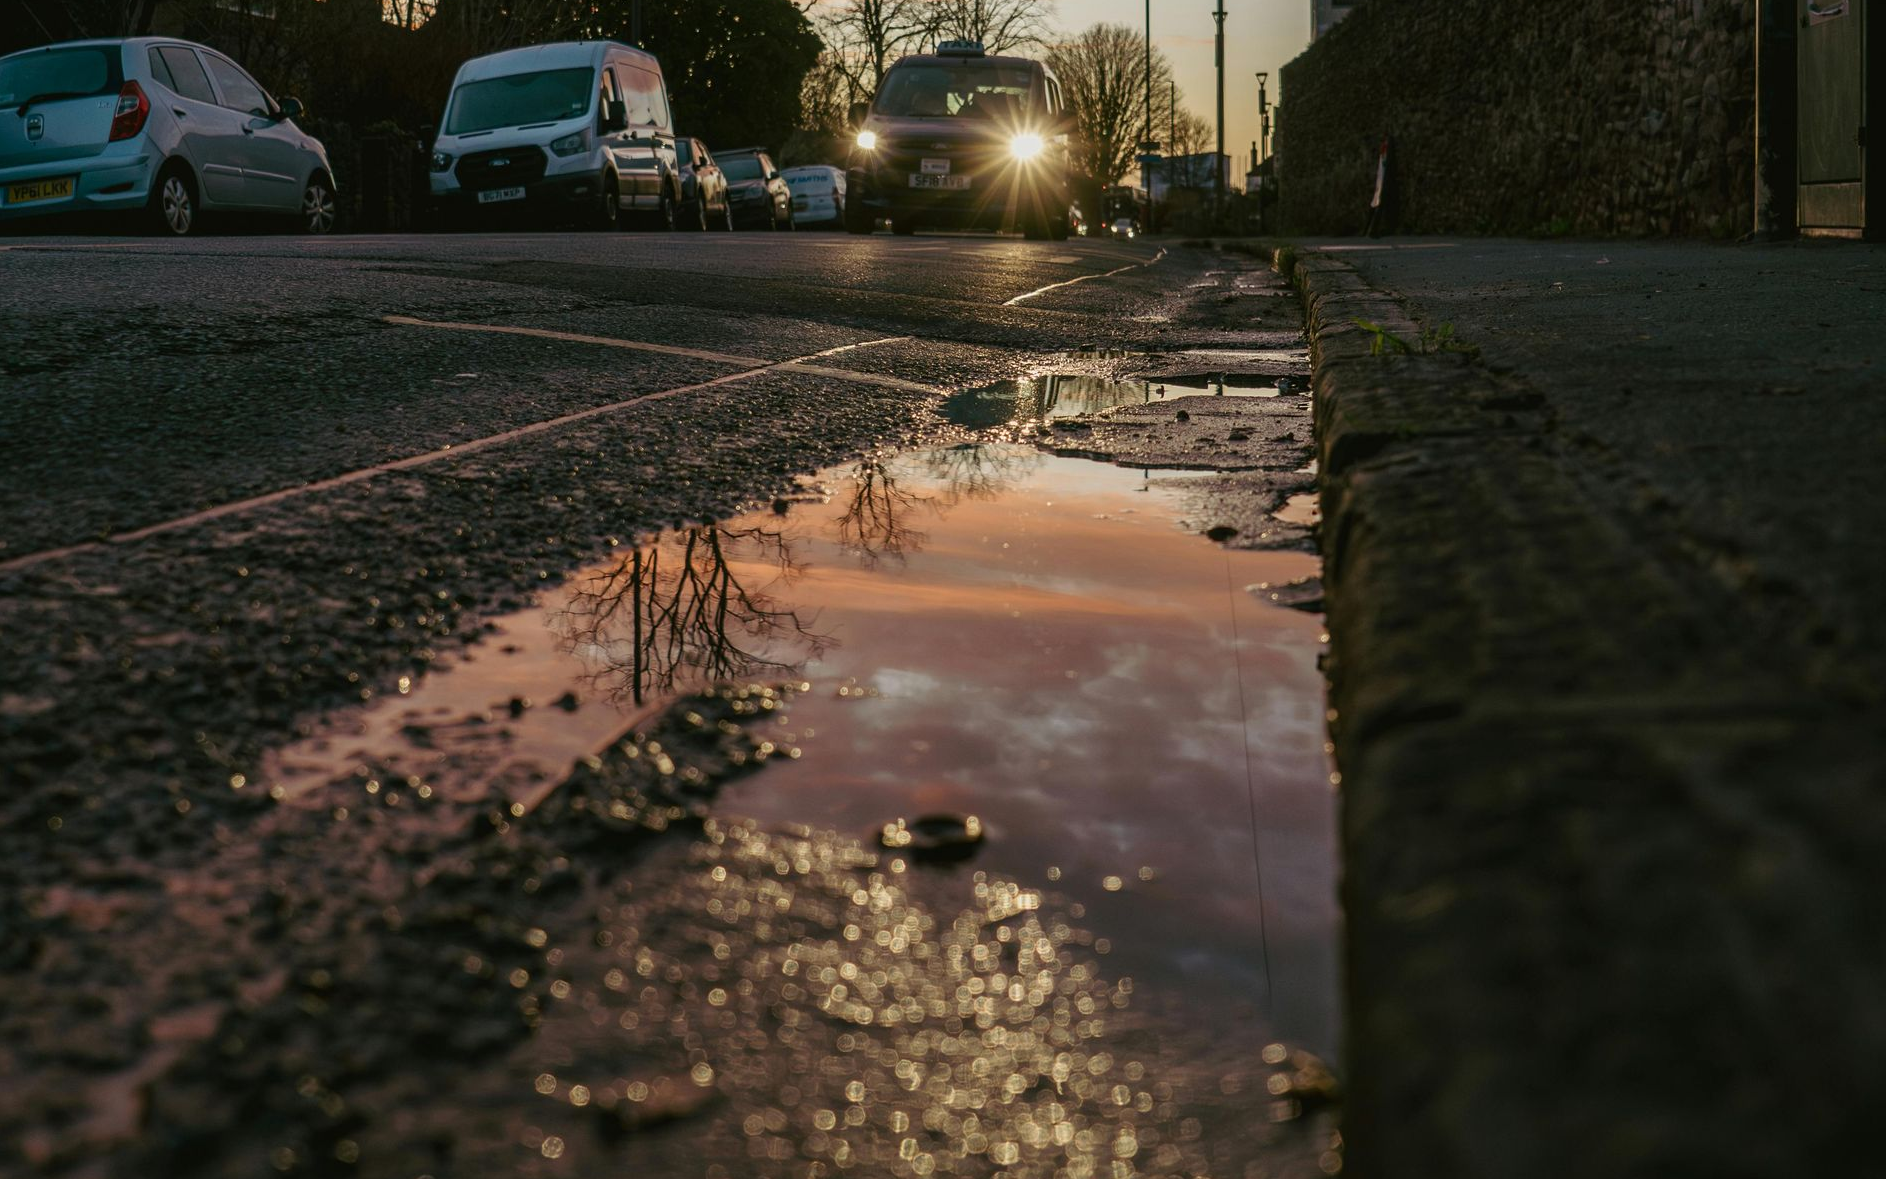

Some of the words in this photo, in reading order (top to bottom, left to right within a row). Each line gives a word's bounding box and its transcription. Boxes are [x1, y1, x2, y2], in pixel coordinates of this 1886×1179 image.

[943, 41, 981, 50] TAXI
[13, 182, 40, 200] YP61
[43, 179, 69, 197] LKK
